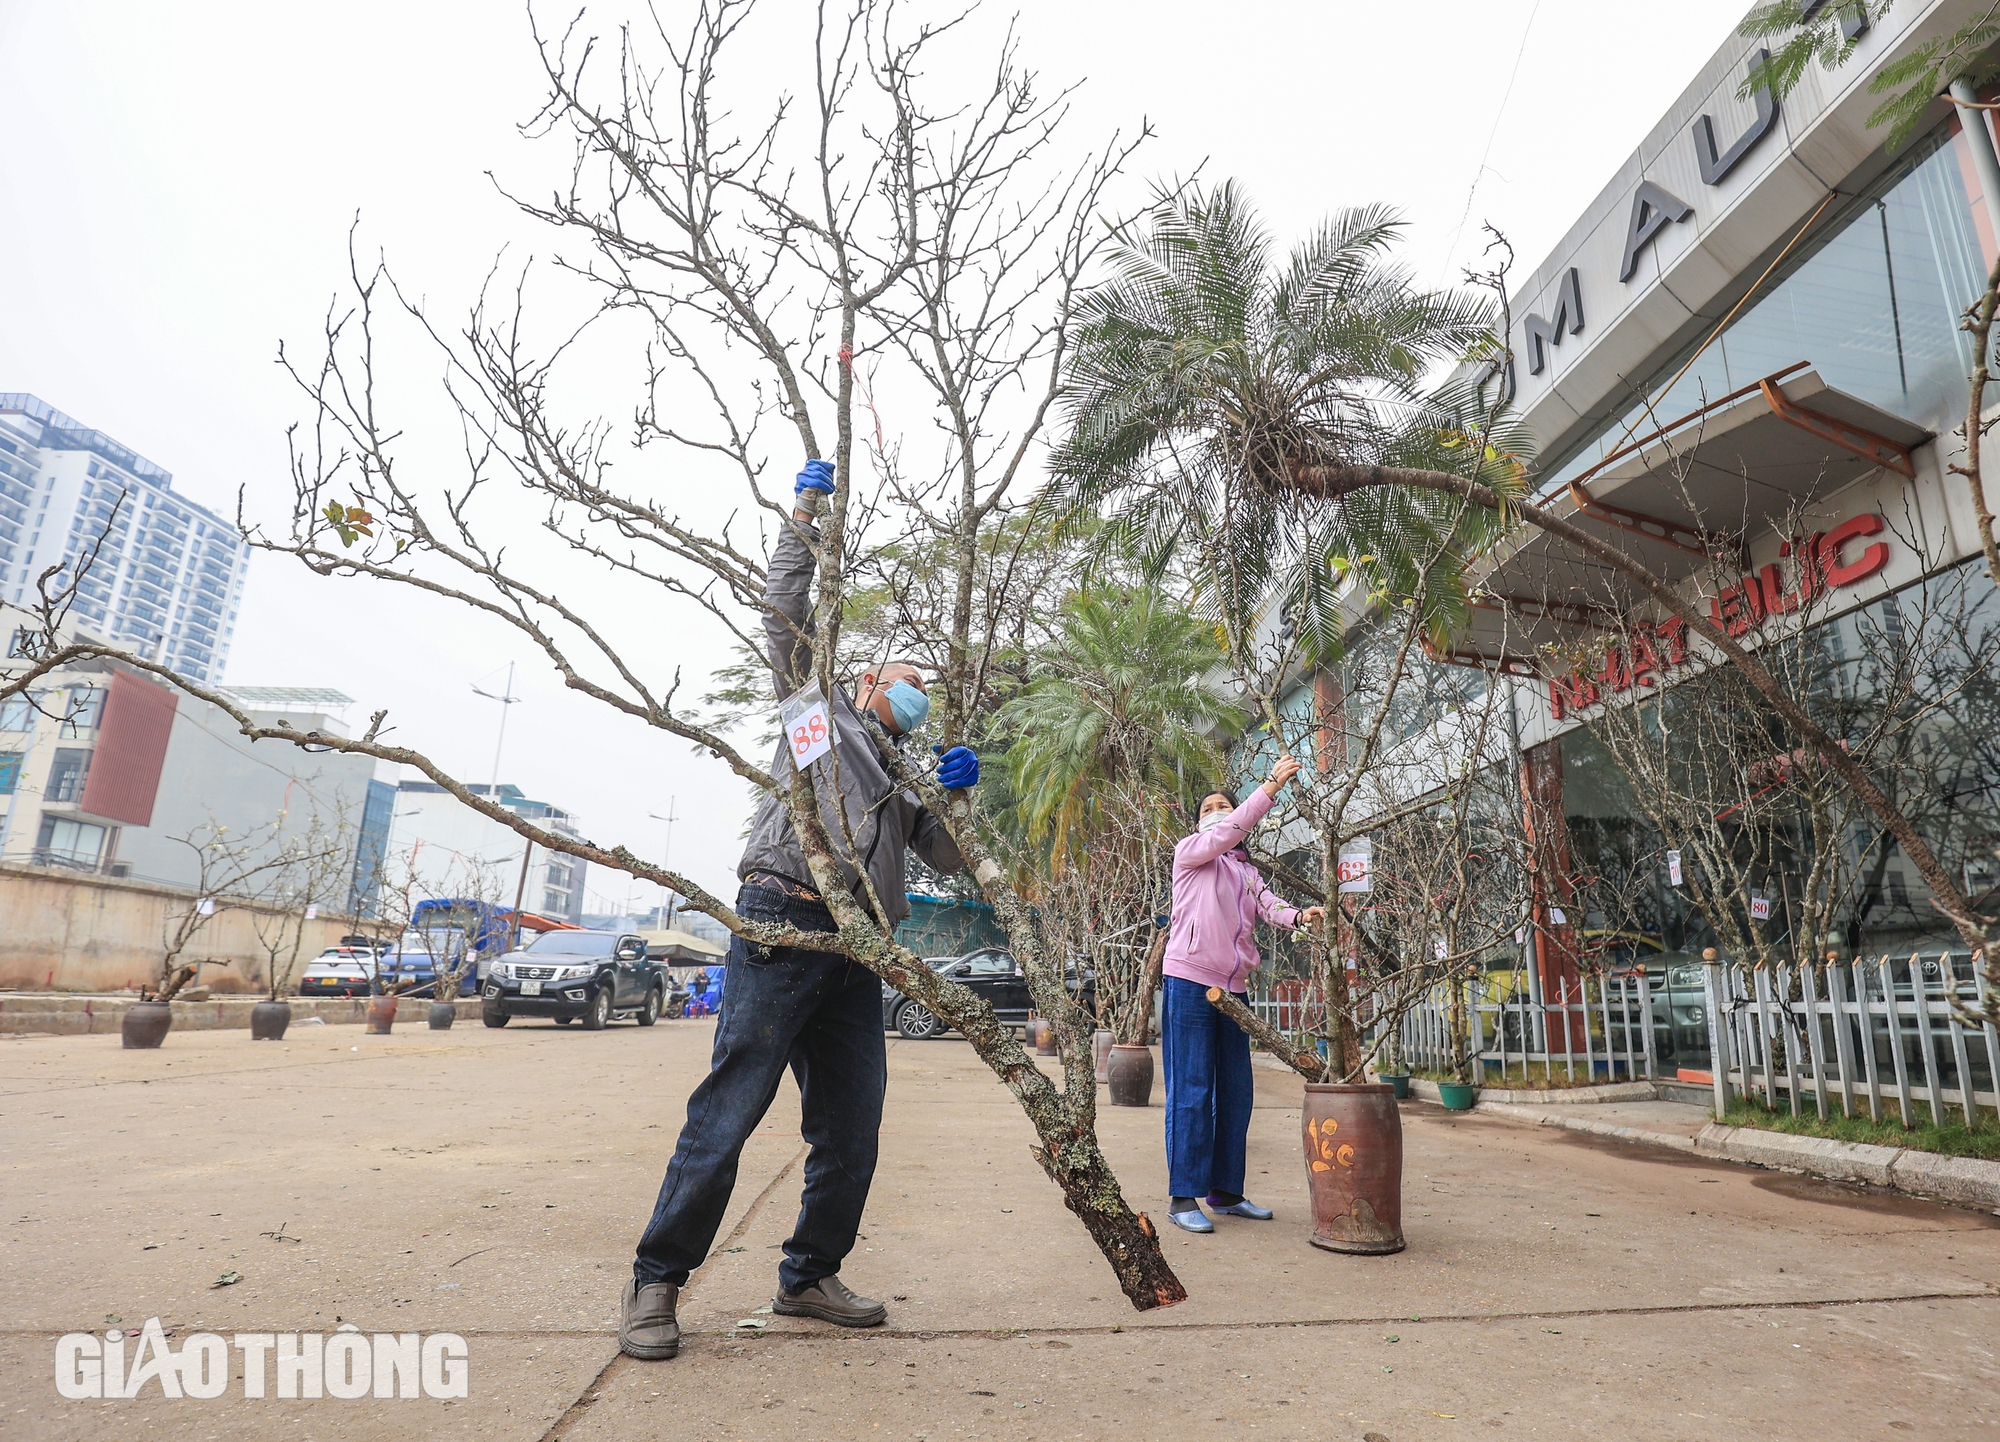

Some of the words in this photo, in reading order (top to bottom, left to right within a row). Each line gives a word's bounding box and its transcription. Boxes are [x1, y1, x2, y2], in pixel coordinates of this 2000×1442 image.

[793, 714, 827, 755] 88
[1337, 861, 1366, 882] 63
[1671, 866, 1680, 879] 70
[1753, 902, 1767, 915] 80
